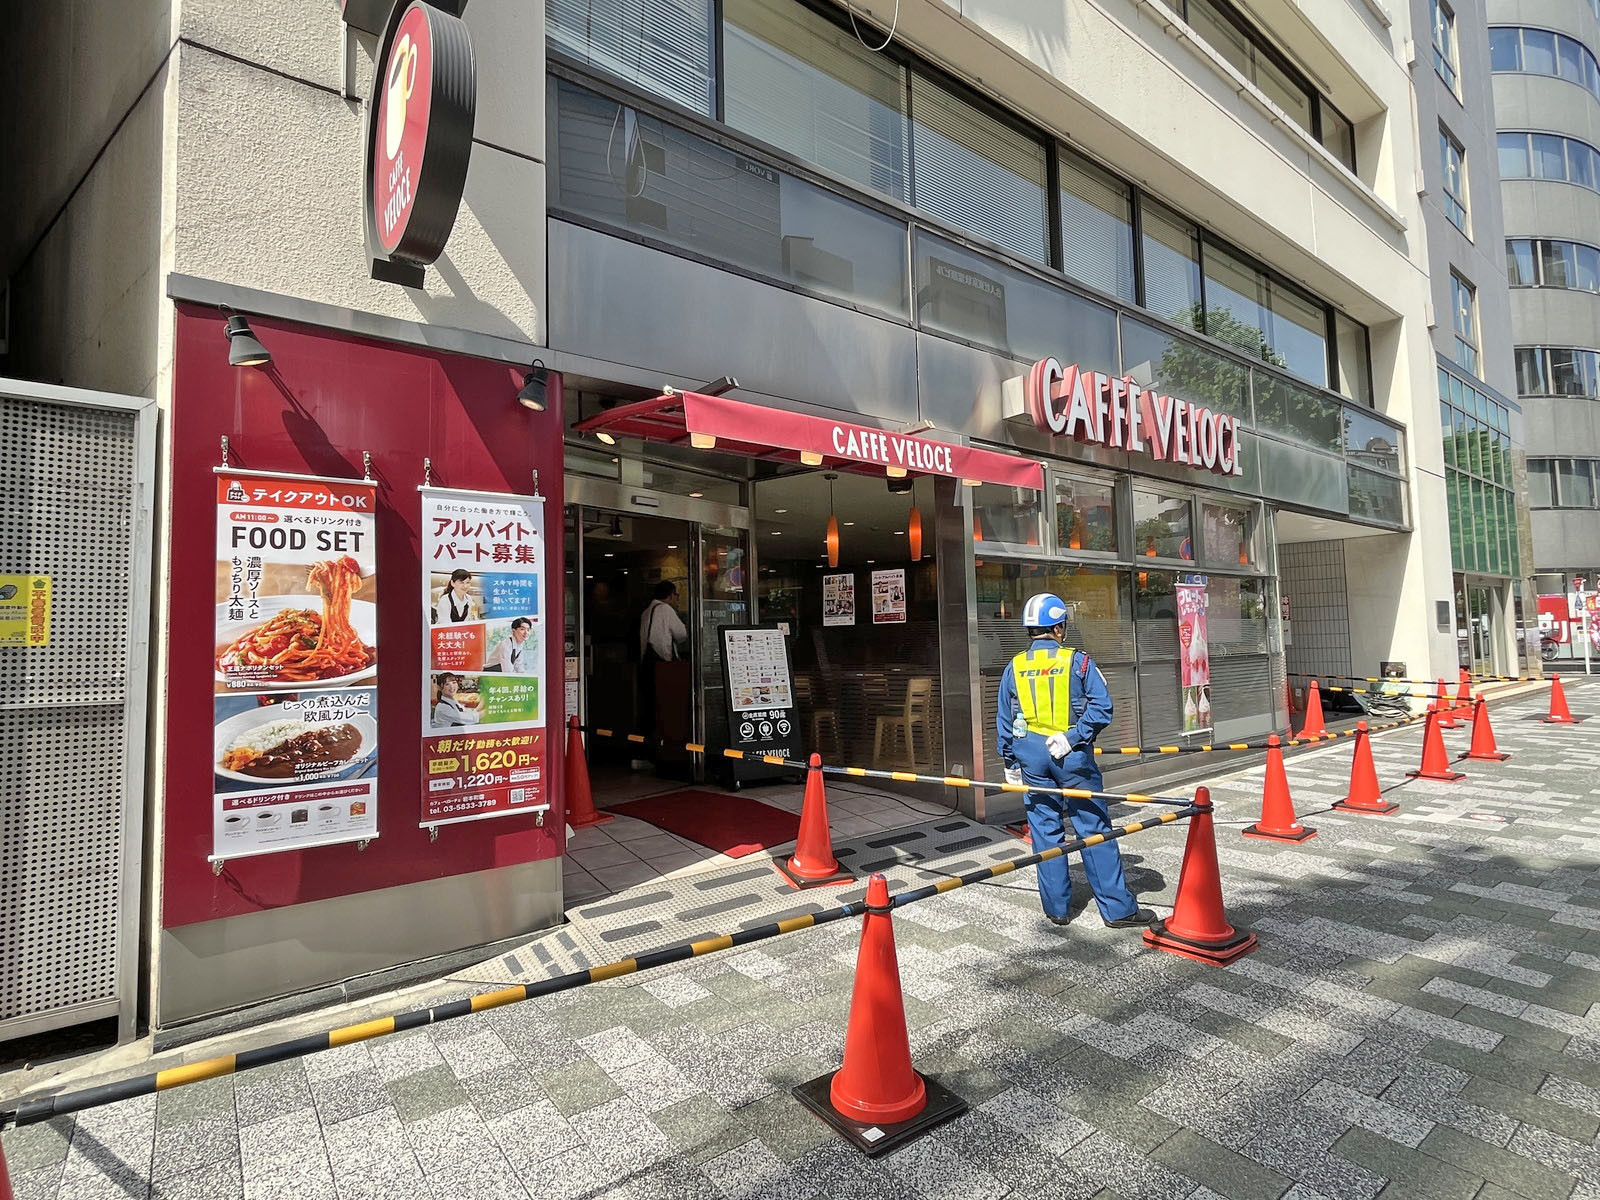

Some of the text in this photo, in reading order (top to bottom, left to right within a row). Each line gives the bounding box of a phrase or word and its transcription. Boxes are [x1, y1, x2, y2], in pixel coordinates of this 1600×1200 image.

[384, 167, 411, 238] VELOCE
[1147, 390, 1244, 477] VELOCE
[893, 438, 953, 473] VELOCE
[253, 487, 368, 509] テイクアウトOK
[283, 514, 363, 527] 選べるドリンク付き
[436, 504, 532, 518] 自分に合った働き方で輝こう。
[231, 526, 365, 552] FOOD SET
[432, 517, 538, 541] アルバイト・
[433, 541, 536, 565] パート募集
[228, 556, 244, 621] もっちり太麺
[247, 556, 263, 620] 濃厚ソースと
[493, 579, 534, 588] スキマ時間を
[493, 588, 520, 596] 生かして
[437, 631, 476, 641] 未経験でも
[283, 692, 370, 711] じっくり煮込んだ
[303, 709, 369, 723] 欧風カレー
[231, 793, 291, 806] 選べるドリンク付き
